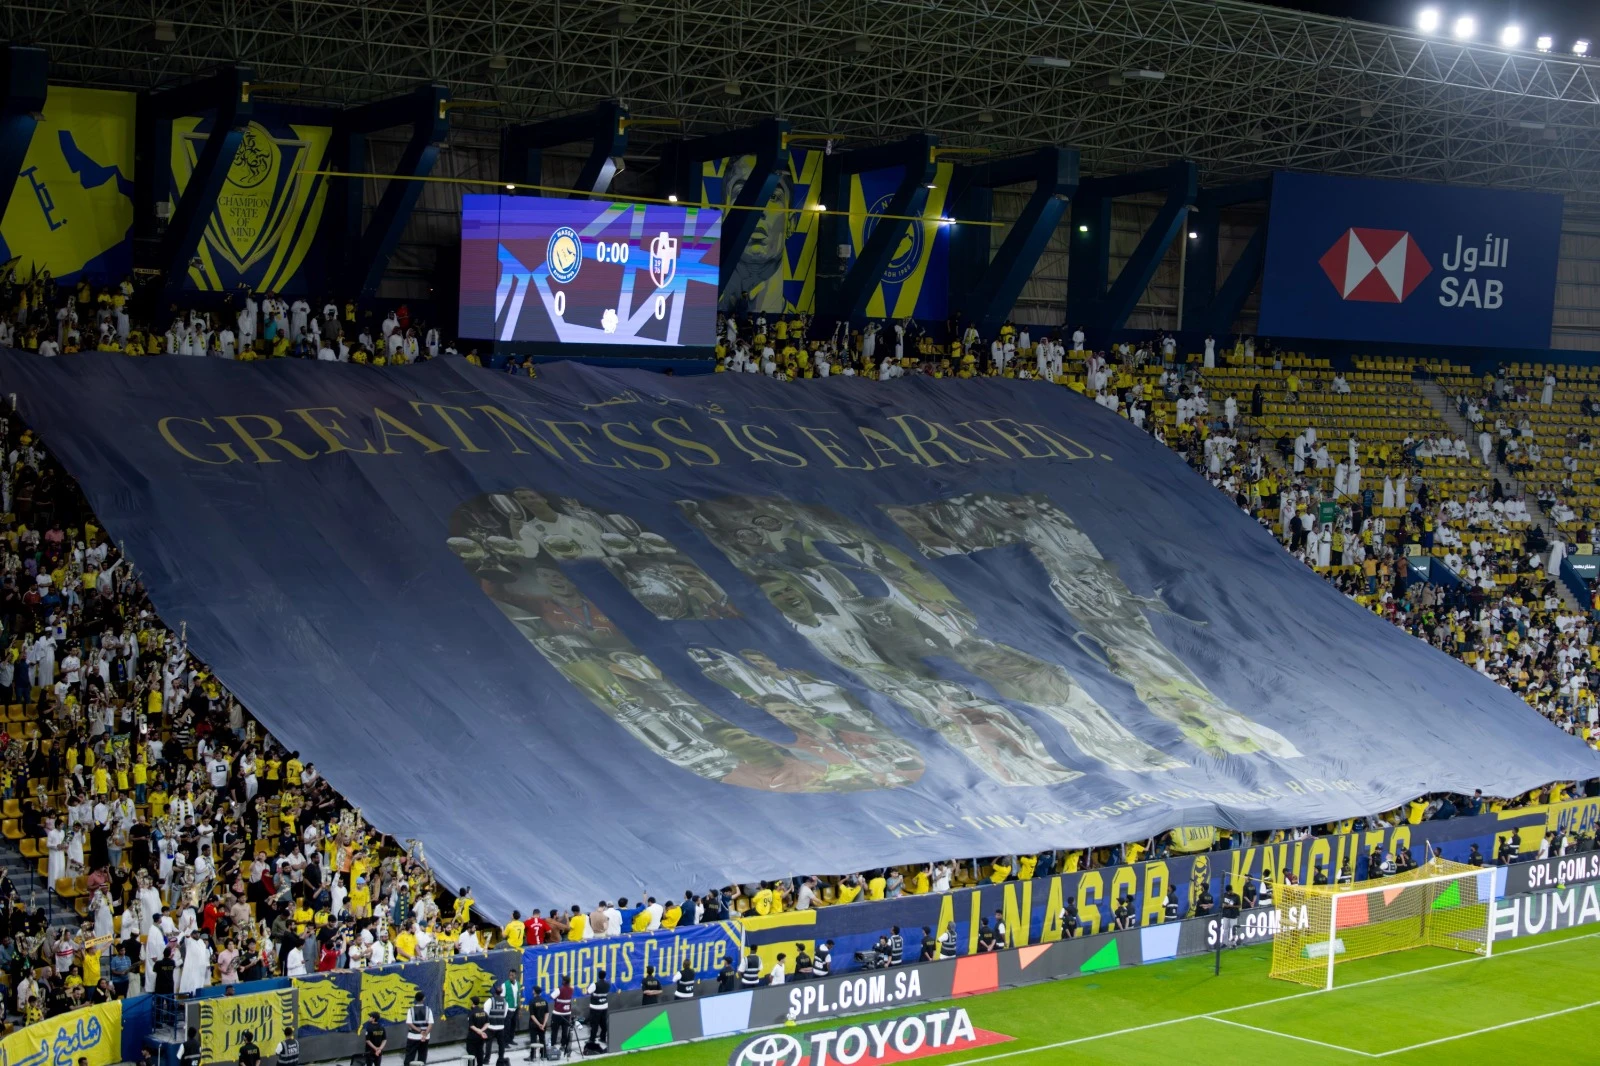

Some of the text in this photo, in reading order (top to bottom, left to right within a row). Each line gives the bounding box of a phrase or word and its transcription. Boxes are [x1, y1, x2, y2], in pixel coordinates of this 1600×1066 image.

[218, 196, 270, 208] CHAMPION
[229, 207, 259, 218] STATE
[230, 226, 256, 238] MIND
[236, 217, 251, 228] OF
[596, 242, 629, 264] 0:00
[1443, 232, 1508, 273] الأول
[554, 290, 566, 317] 0
[655, 295, 666, 320] 0
[1439, 276, 1504, 310] SAB
[157, 400, 1113, 471] GREATNESS IS EARNED.
[1578, 803, 1600, 833] AR
[1528, 854, 1600, 888] SPL.COM.S
[1003, 861, 1169, 949] NASSR
[1207, 904, 1309, 945] S.COM.SA
[537, 935, 727, 994] KNIGHTS Culture
[789, 969, 922, 1017] SPL.COM.SA
[810, 1008, 976, 1066] TOYOTA
